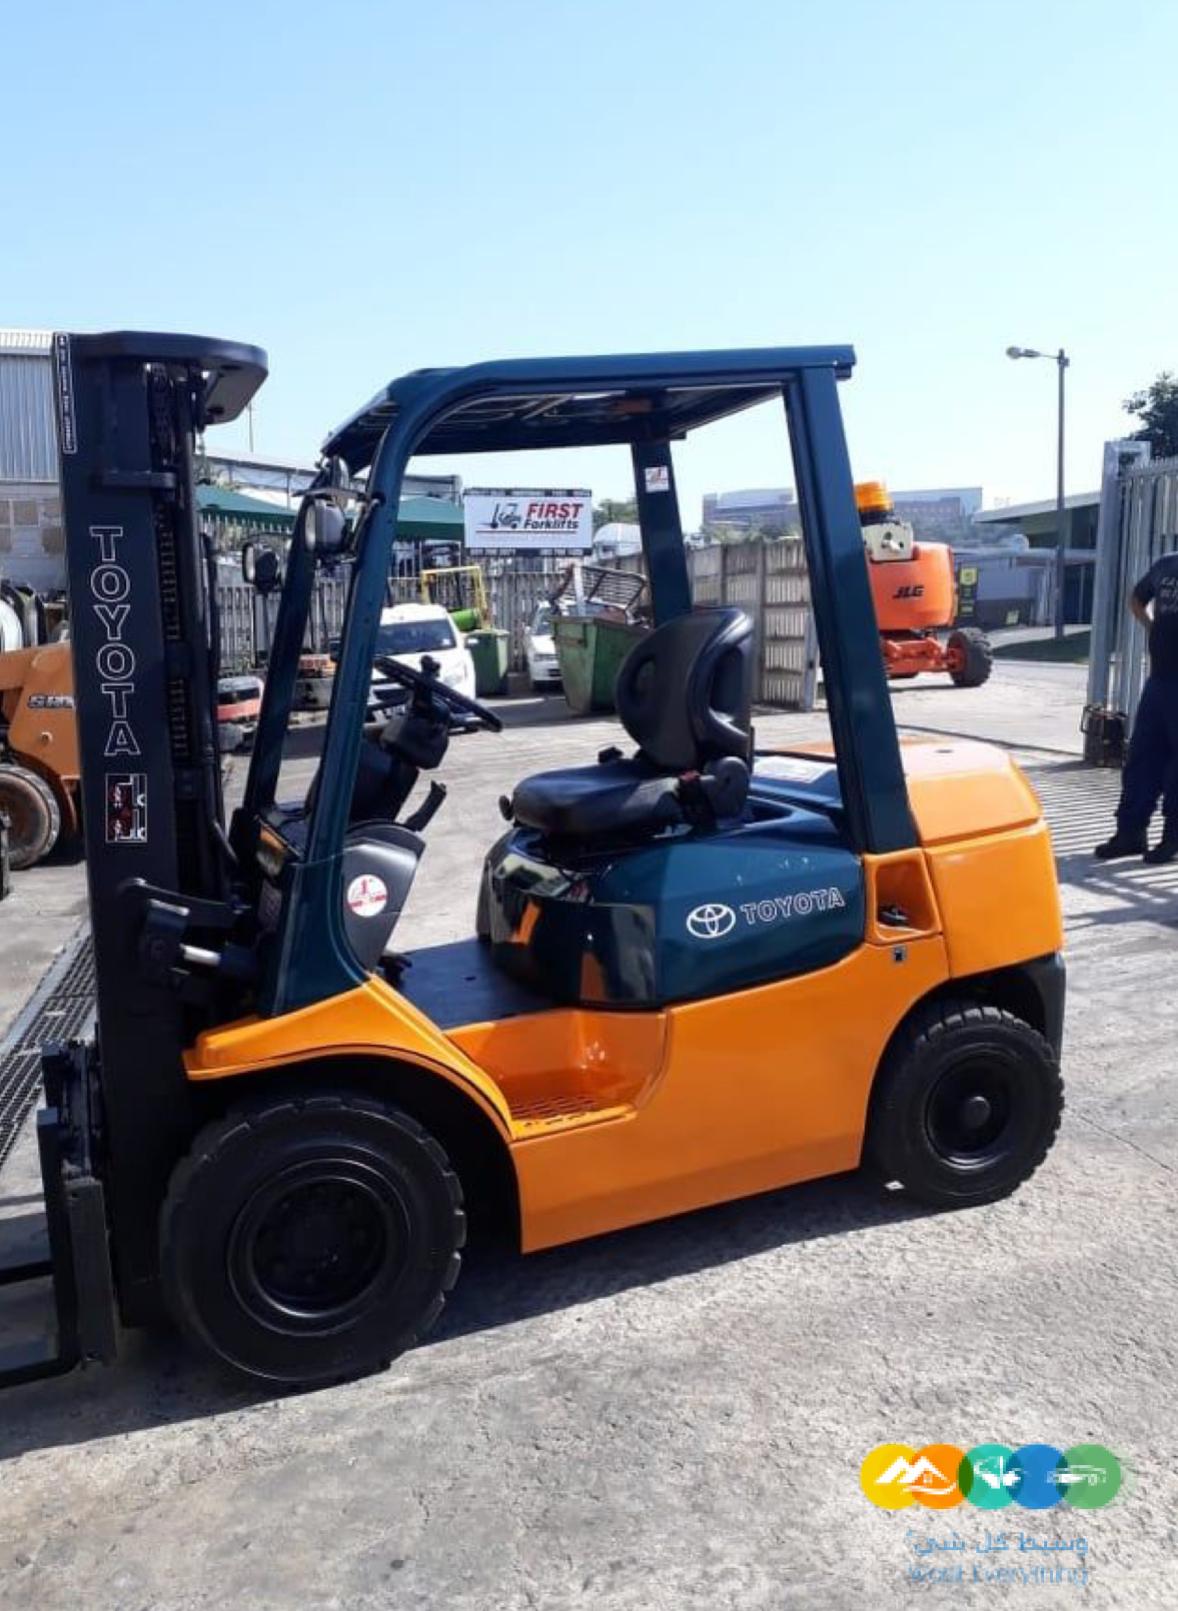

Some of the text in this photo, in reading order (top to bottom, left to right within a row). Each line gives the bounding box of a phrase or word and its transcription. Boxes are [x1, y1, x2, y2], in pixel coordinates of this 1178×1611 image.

[527, 503, 584, 519] FIRST
[524, 517, 579, 529] Forklifts
[892, 584, 925, 599] JLG
[89, 526, 141, 756] TOYOTA
[740, 887, 846, 925] TOYOTA
